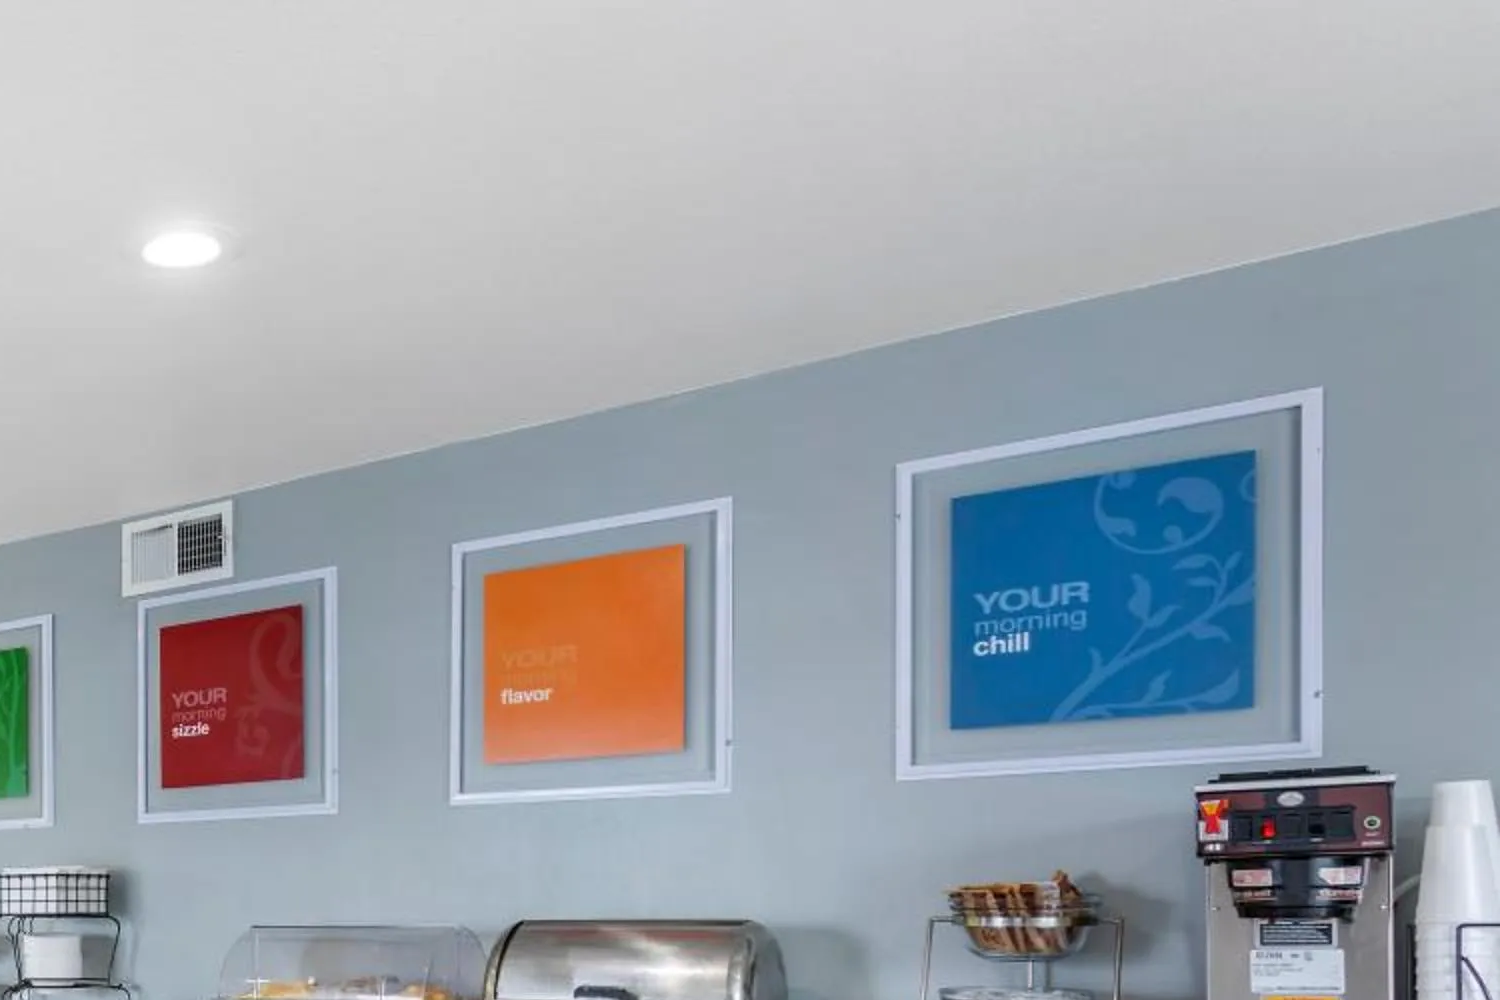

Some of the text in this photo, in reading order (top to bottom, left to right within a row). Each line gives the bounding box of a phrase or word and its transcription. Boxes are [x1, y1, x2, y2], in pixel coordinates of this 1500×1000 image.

[973, 581, 1089, 615] YOUR
[974, 608, 1087, 637] morning
[973, 631, 1029, 656] chill
[171, 687, 227, 709] YOUR
[500, 687, 554, 705] flavor
[171, 721, 210, 738] sizzle
